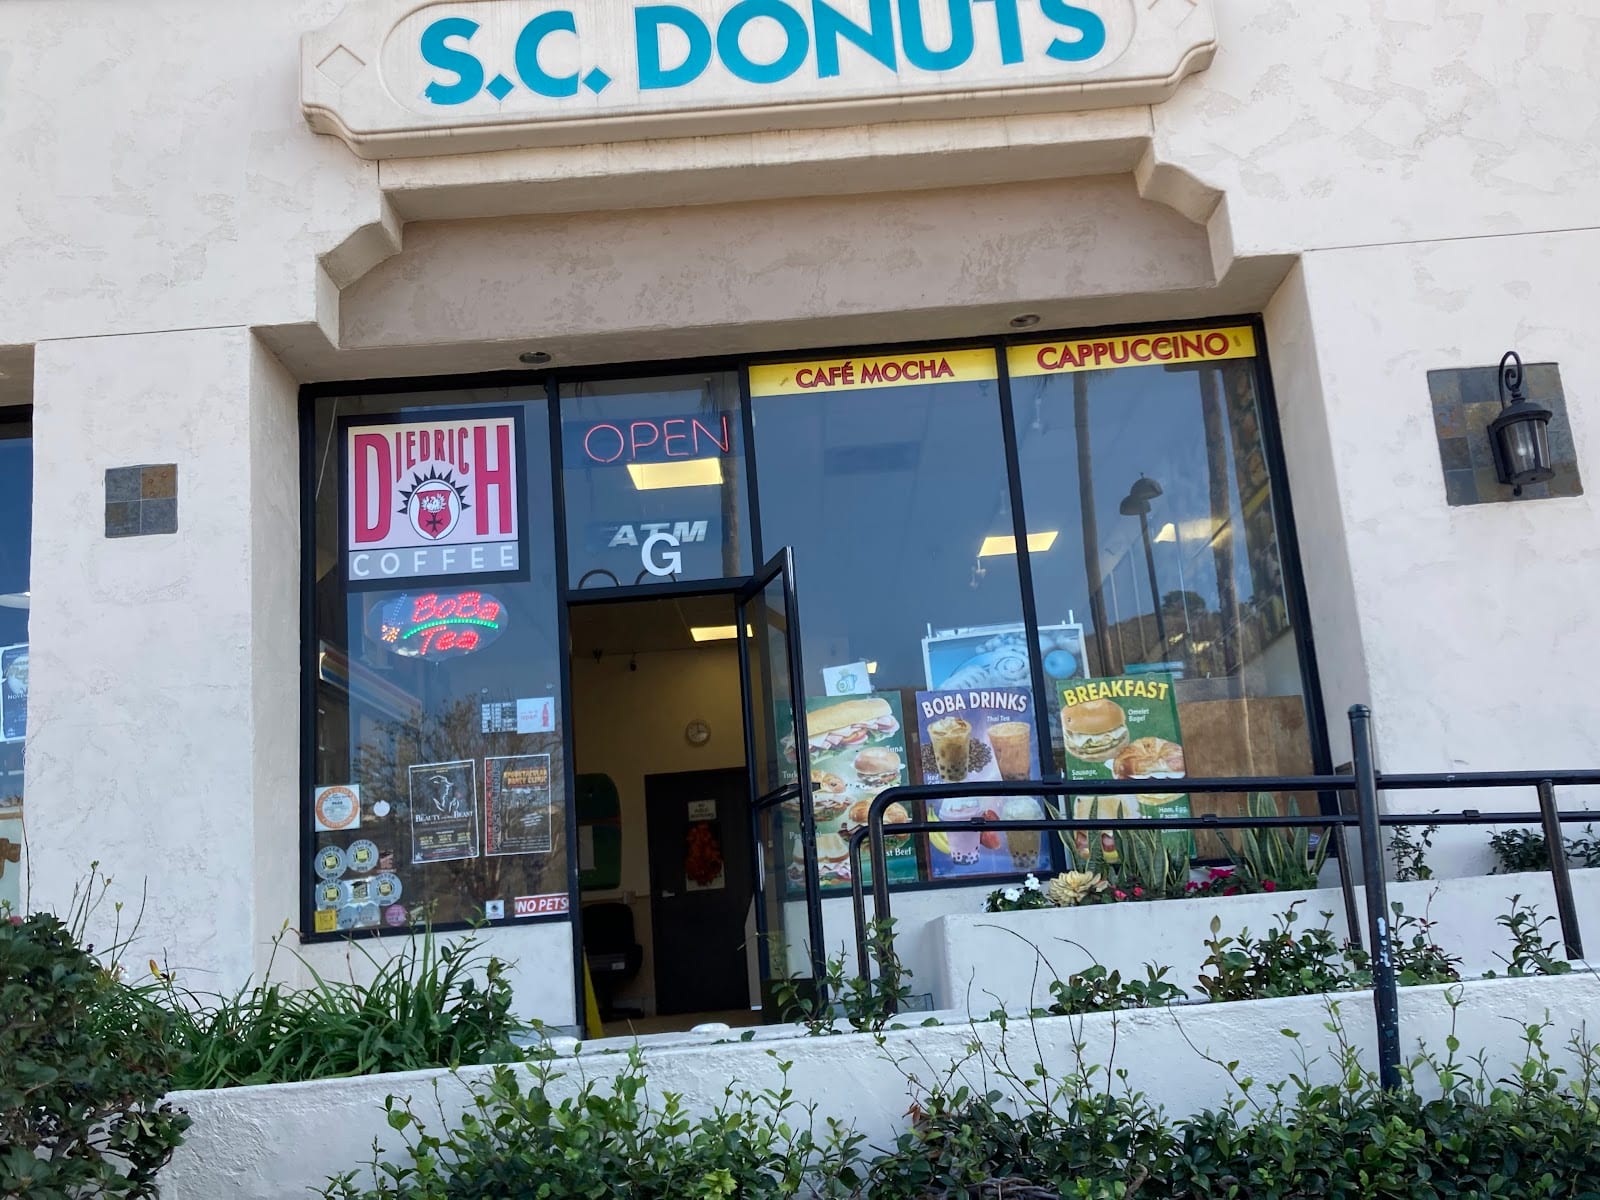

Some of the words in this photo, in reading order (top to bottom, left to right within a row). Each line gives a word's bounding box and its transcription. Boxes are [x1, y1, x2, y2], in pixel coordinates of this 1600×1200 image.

[419, 10, 613, 107] S.C.
[638, 0, 1107, 91] DONUTS
[1036, 332, 1230, 371] CAPPUCCINO
[795, 360, 855, 389] CAFÉ
[860, 357, 955, 386] MOCHA
[584, 415, 730, 464] OPEN
[354, 424, 513, 544] DIEDRICH
[608, 520, 709, 548] ATM
[353, 545, 514, 577] COFFEE
[641, 532, 683, 577] G
[921, 693, 967, 719] BOBA
[969, 691, 1028, 713] DRINKS
[1063, 679, 1169, 707] BREAKFAST
[1128, 708, 1150, 716] Omelet
[1128, 715, 1146, 723] Bagel
[886, 745, 904, 753] Tuna
[895, 847, 912, 856] Beef
[517, 899, 537, 913] NO
[538, 896, 568, 912] PETS
